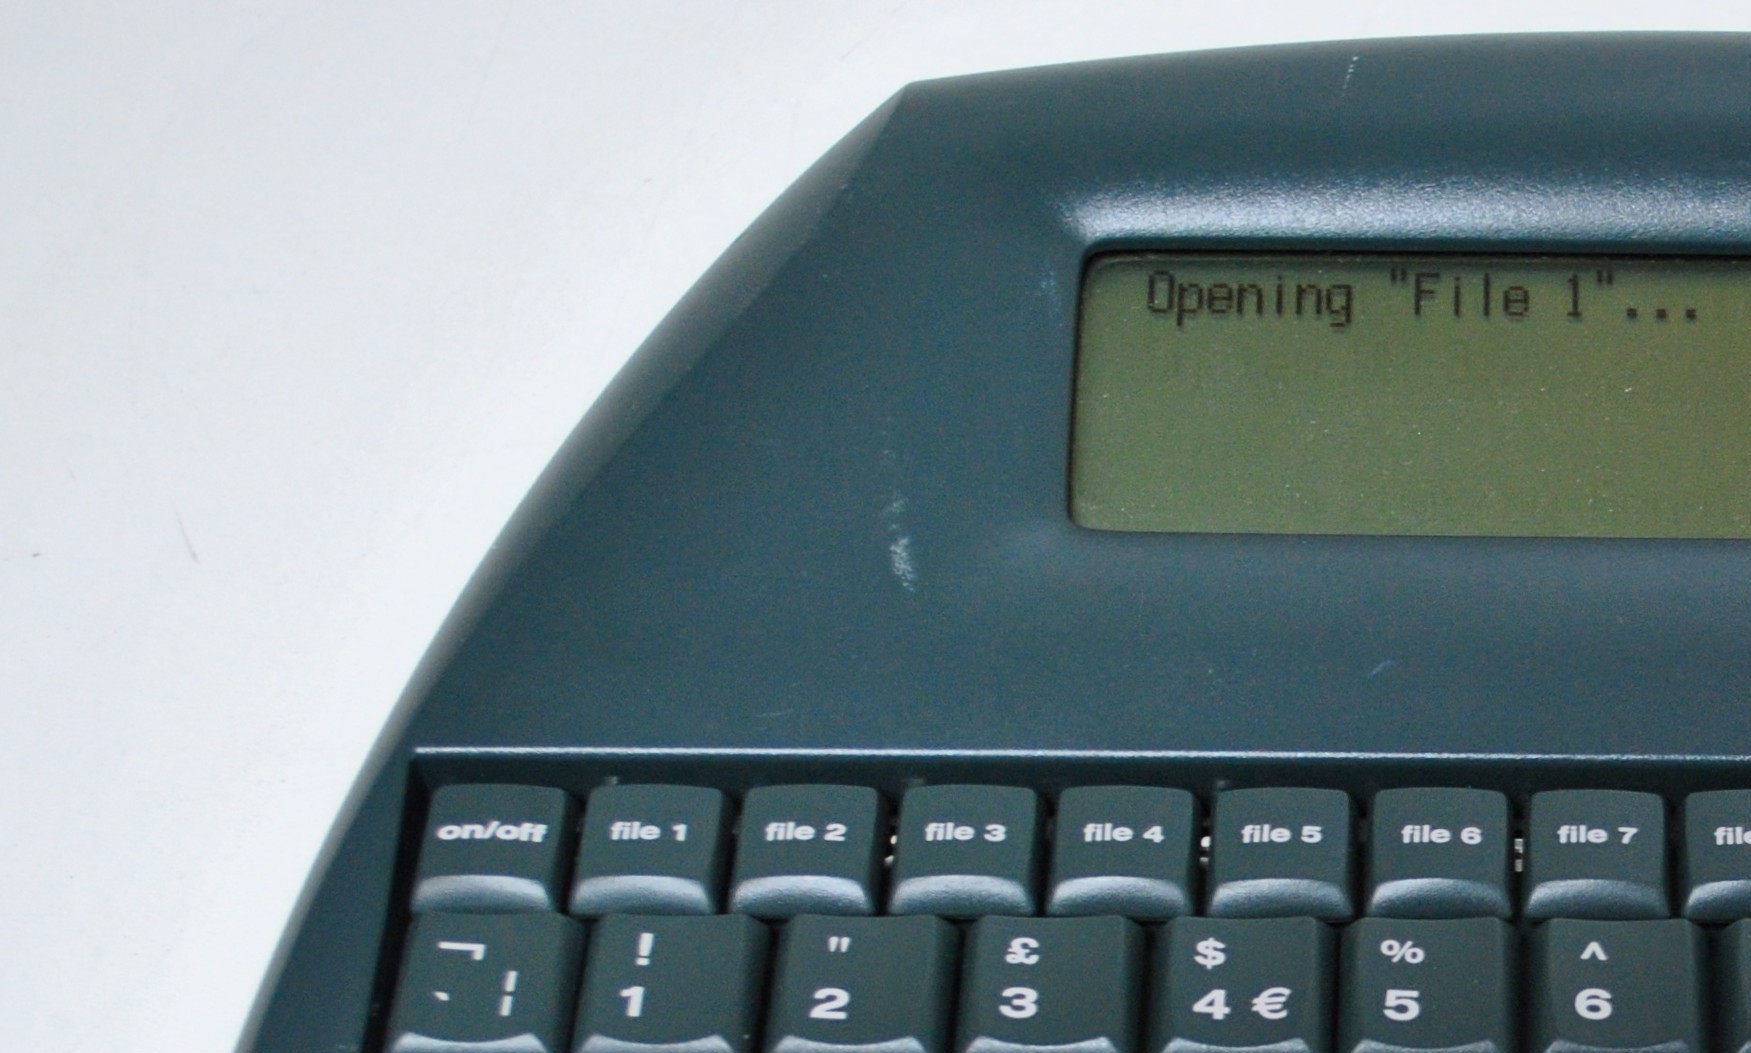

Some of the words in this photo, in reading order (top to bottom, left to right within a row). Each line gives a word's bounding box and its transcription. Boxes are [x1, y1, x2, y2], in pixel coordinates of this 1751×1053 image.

[1147, 270, 1352, 328] Opening
[1391, 267, 1531, 320] "File
[436, 820, 548, 843] on/off
[610, 820, 660, 841] file
[672, 823, 688, 842] 1
[765, 821, 815, 842] file
[823, 822, 847, 842] 2
[924, 821, 975, 842] file
[983, 823, 1007, 842] 3
[1083, 822, 1133, 843] file
[1142, 825, 1165, 843] 4
[1240, 823, 1292, 844] file
[1302, 825, 1323, 844] 5
[1401, 824, 1451, 844] file
[1460, 826, 1483, 845] 6
[1557, 824, 1607, 844] file
[1617, 826, 1639, 845] 7
[635, 932, 654, 966] !
[1004, 936, 1040, 965] £
[1194, 937, 1226, 970] $
[1379, 939, 1425, 964] %
[620, 985, 645, 1018] 1
[809, 987, 850, 1020] 2
[998, 985, 1039, 1019] 3
[1192, 988, 1231, 1020] 4
[1251, 985, 1292, 1020] €
[1383, 988, 1421, 1022] 5
[1574, 987, 1613, 1021] 6
